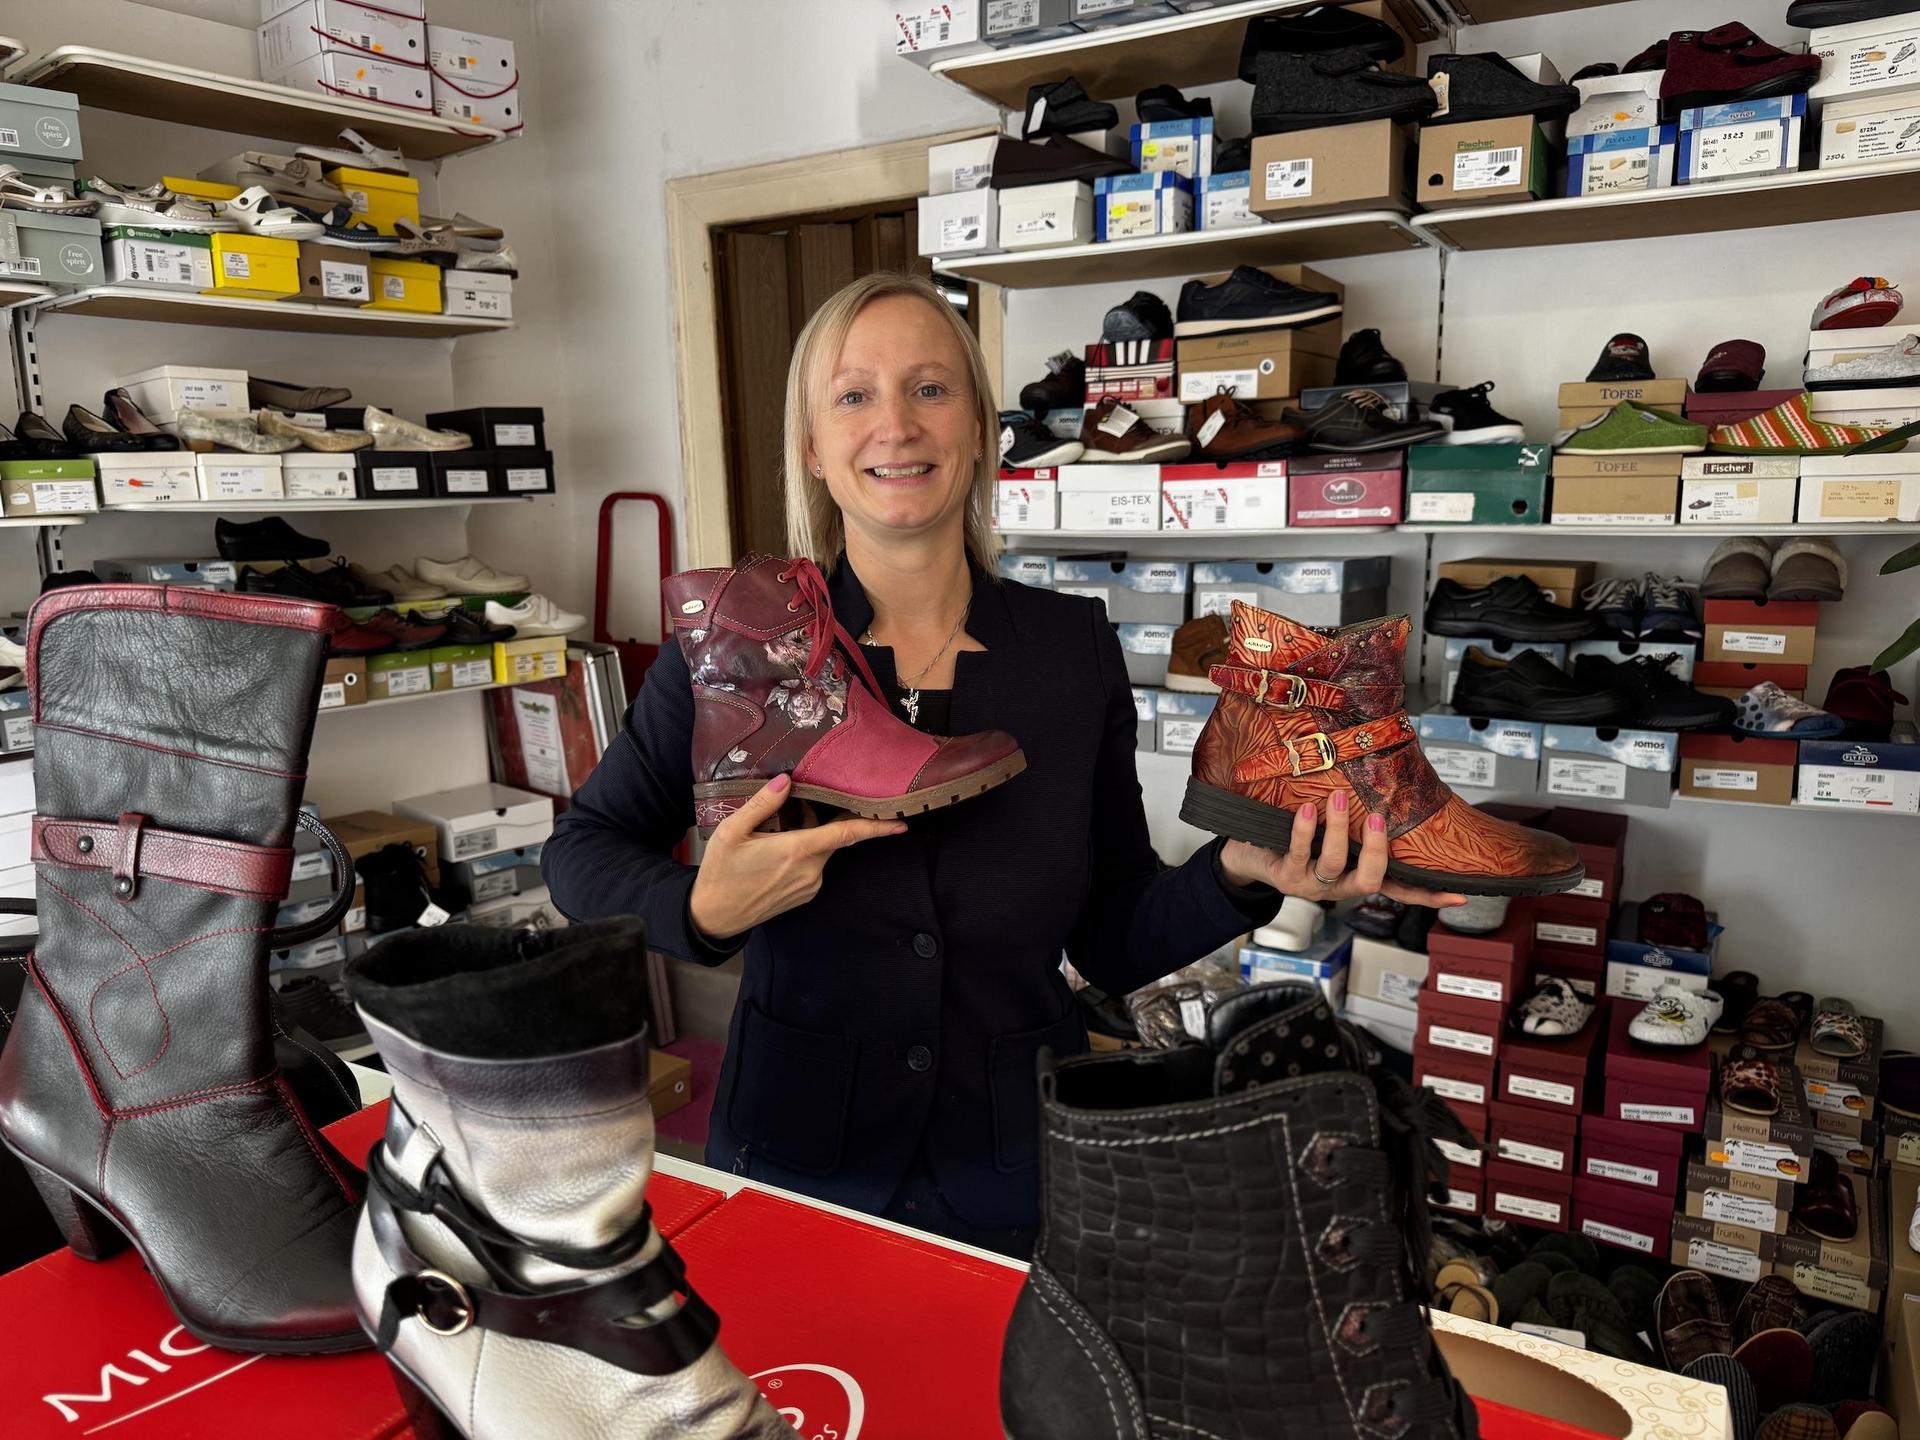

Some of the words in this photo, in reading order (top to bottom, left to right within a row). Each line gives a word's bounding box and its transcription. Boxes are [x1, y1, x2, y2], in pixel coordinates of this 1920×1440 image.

[43, 122, 60, 132] free
[42, 130, 63, 140] spirit
[1457, 139, 1495, 149] Fischer
[67, 249, 84, 259] free
[130, 244, 138, 271] remonte
[65, 257, 86, 267] spirit
[1600, 388, 1644, 400] TOFEE
[1594, 461, 1639, 473] TOFEE
[1710, 463, 1747, 473] Fischer
[1111, 495, 1152, 506] EIS-TEX
[1884, 497, 1895, 506] 38
[1732, 1122, 1767, 1137] Helmut
[1772, 1128, 1802, 1141] Trunte
[1692, 1168, 1727, 1184] Helmut
[1731, 1176, 1761, 1190] Trunte
[1677, 1219, 1712, 1233] Helmut
[1715, 1226, 1745, 1241] Trunte
[1690, 1248, 1698, 1256] 37
[1781, 1240, 1817, 1257] Helmut
[1822, 1251, 1854, 1267] Trunte
[41, 1323, 213, 1423] MIC
